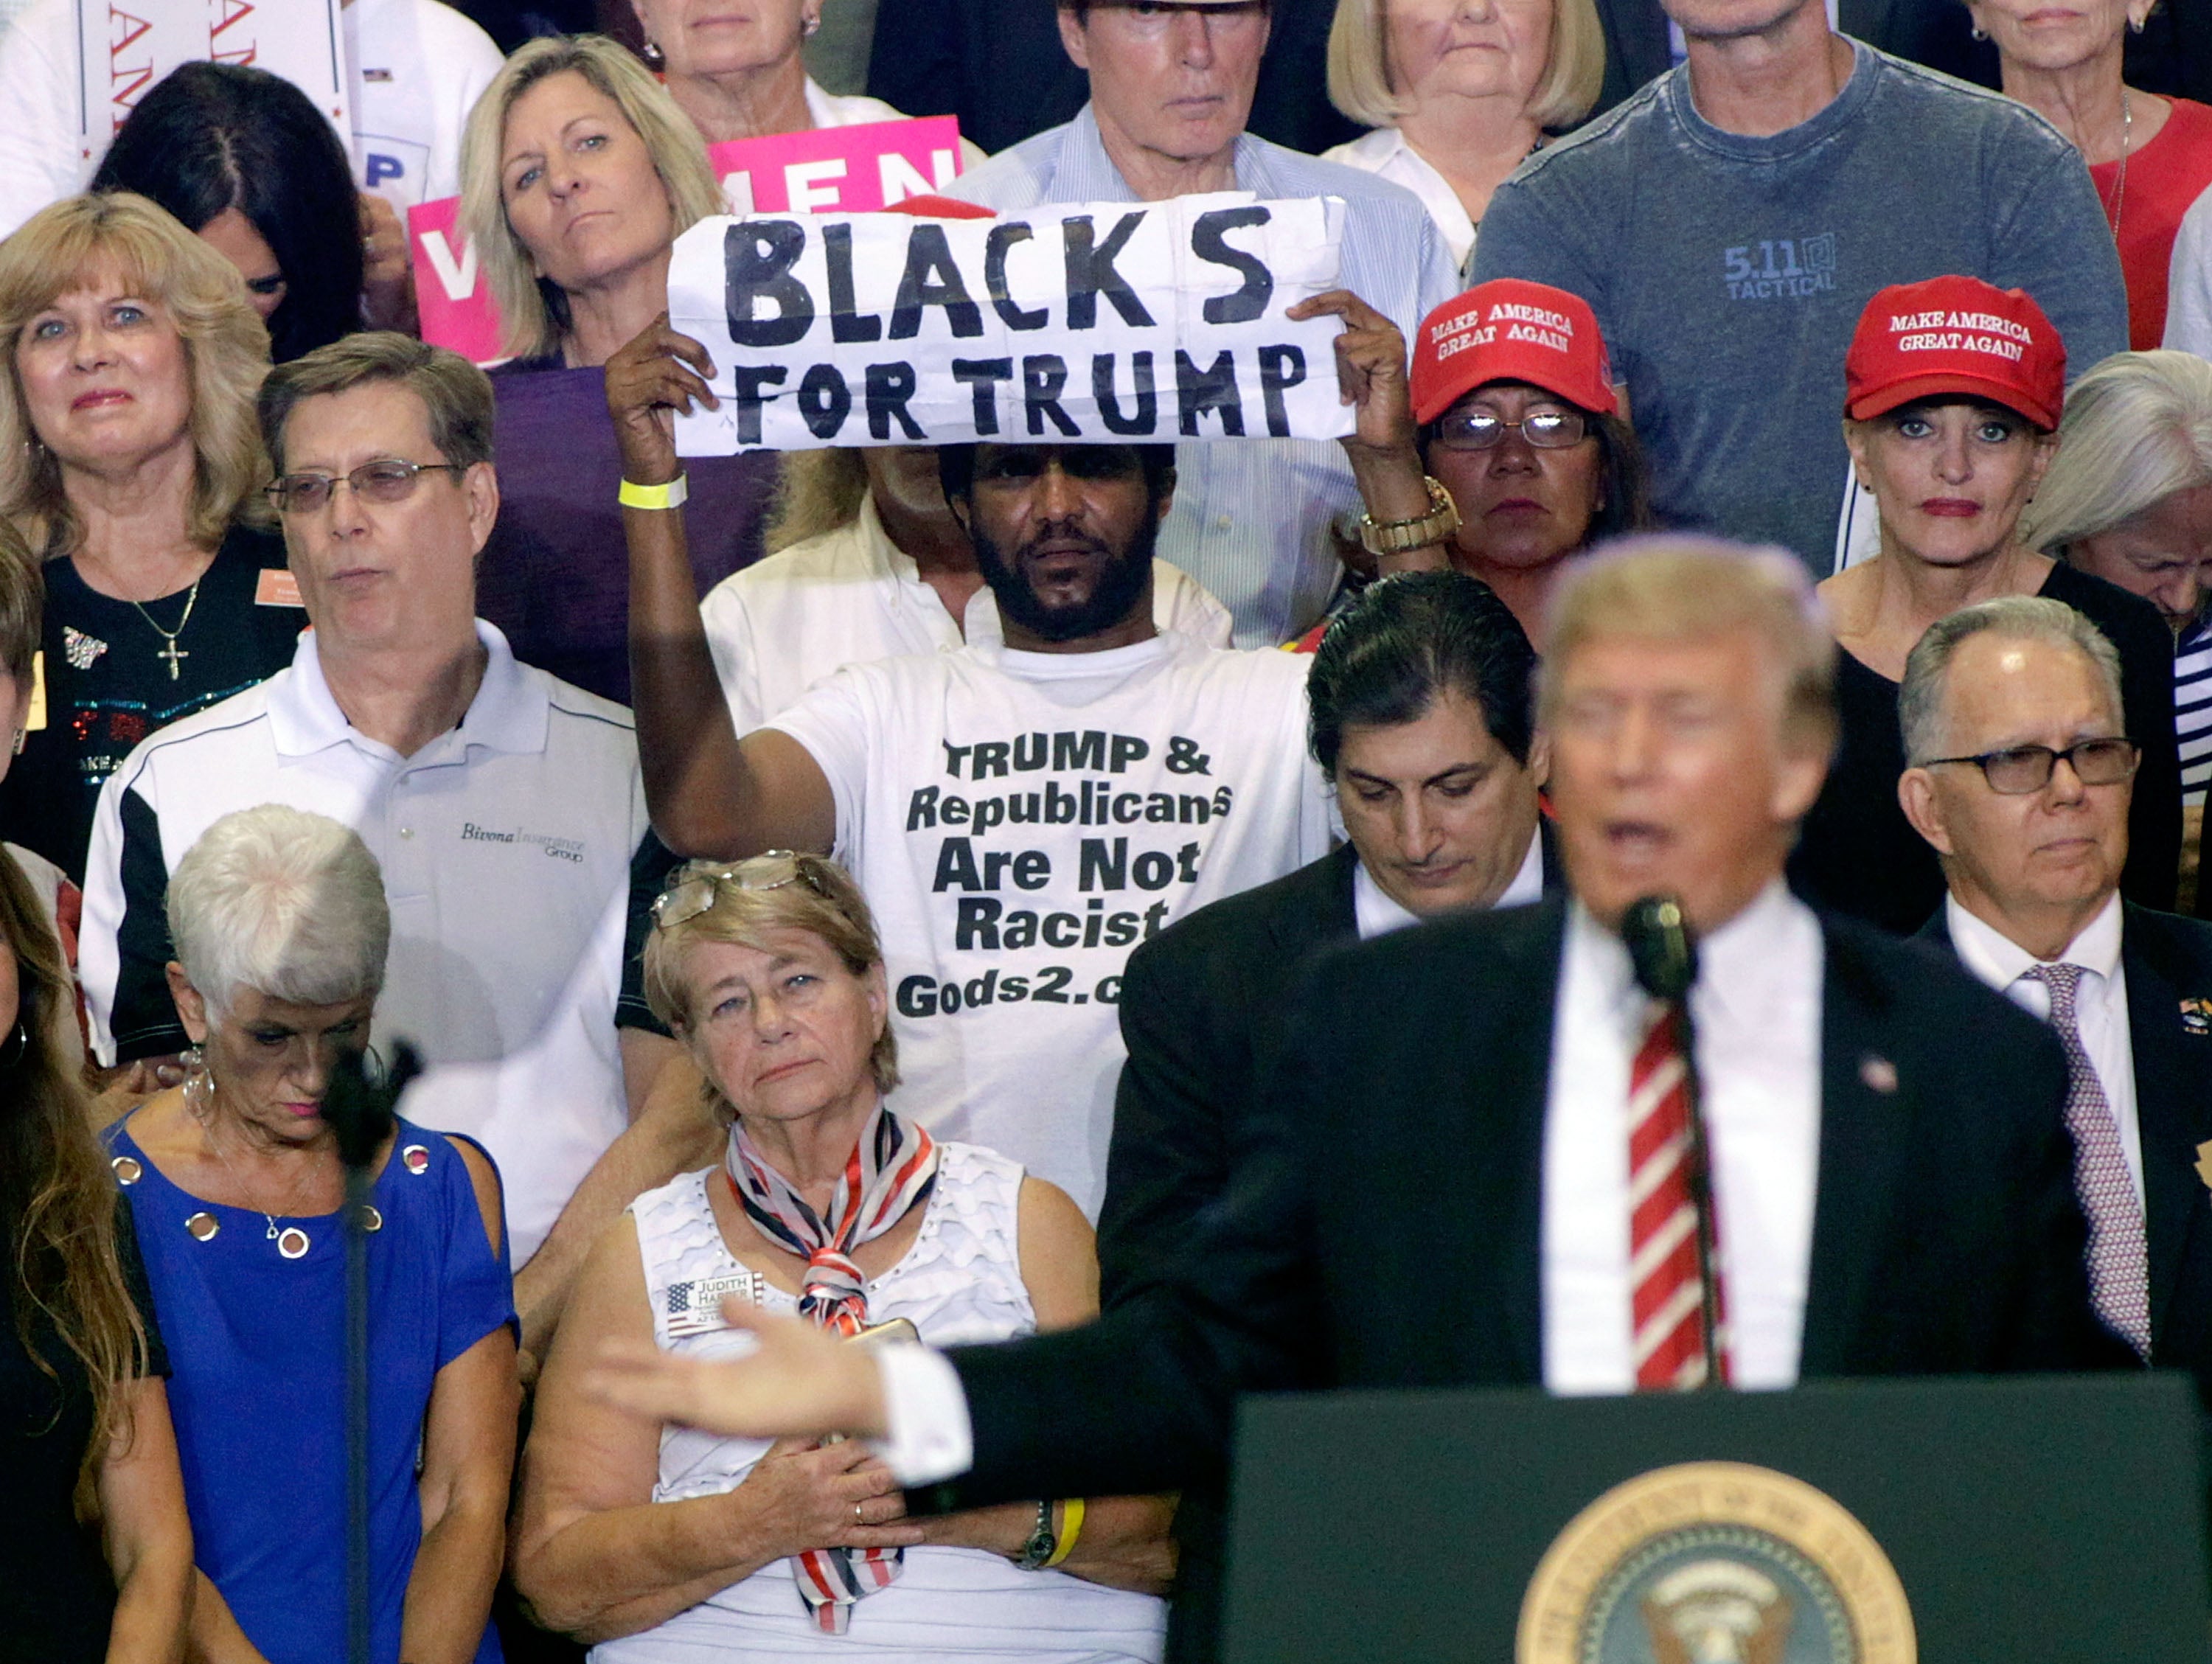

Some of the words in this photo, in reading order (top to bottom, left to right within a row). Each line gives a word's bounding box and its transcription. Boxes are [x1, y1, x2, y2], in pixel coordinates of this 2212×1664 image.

[724, 206, 1274, 347] BLACKS
[1725, 240, 1804, 282] 5.11
[1727, 271, 1837, 299] TACTICAL
[1431, 310, 1478, 344] MAKE
[1488, 303, 1573, 336] AMERICA
[1439, 326, 1497, 361] GREAT
[1507, 324, 1568, 352] AGAIN
[1890, 311, 1944, 332] MAKE
[1947, 311, 2033, 344] AMERICA
[1899, 333, 1962, 352] GREAT
[1963, 335, 2023, 362] AGAIN
[734, 361, 928, 444] FOR
[952, 344, 1307, 437] TRUMP
[942, 730, 1150, 781] TRUMP
[1165, 736, 1213, 776] &
[906, 780, 1234, 835] Republicans
[545, 847, 583, 865] Group
[933, 837, 1051, 892] Are
[1079, 837, 1200, 892] Not
[956, 897, 1169, 950] Racist
[698, 1278, 747, 1293] JUDITH
